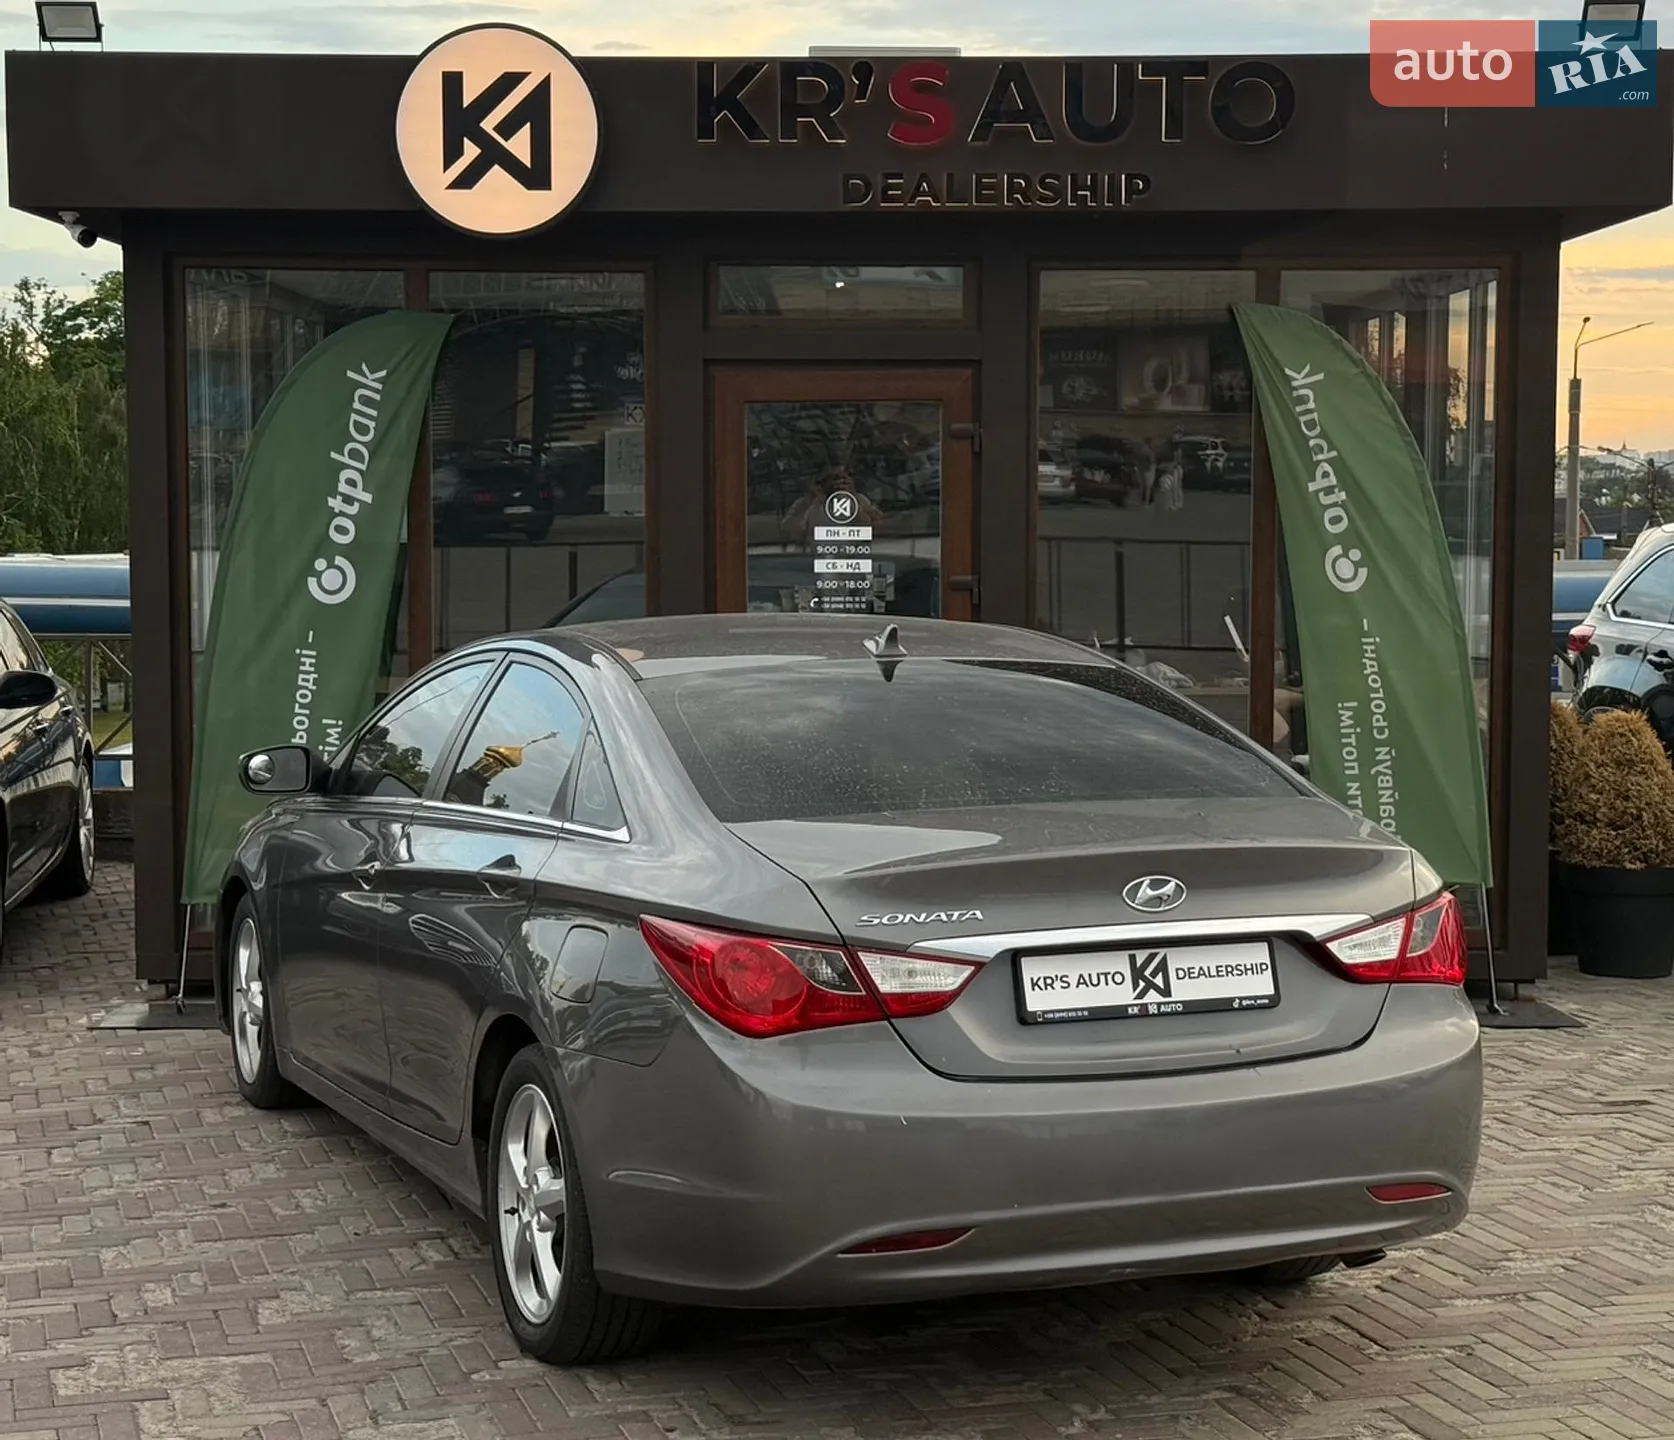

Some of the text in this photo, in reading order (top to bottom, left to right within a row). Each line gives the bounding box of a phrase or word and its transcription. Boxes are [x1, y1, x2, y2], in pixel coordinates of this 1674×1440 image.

[697, 60, 1297, 146] KR'S AUTO
[842, 171, 1153, 208] DEALERSHIP
[327, 361, 388, 545] otpbank
[825, 529, 840, 538] ПН
[848, 529, 862, 538] ПТ
[846, 562, 861, 571] НД
[291, 647, 319, 745] ьогодні
[854, 909, 985, 927] SONATA
[1030, 973, 1071, 992] KR'S
[1075, 971, 1126, 989] AUTO
[1175, 962, 1270, 981] DEALERSHIP
[1160, 1002, 1184, 1013] AUTO
